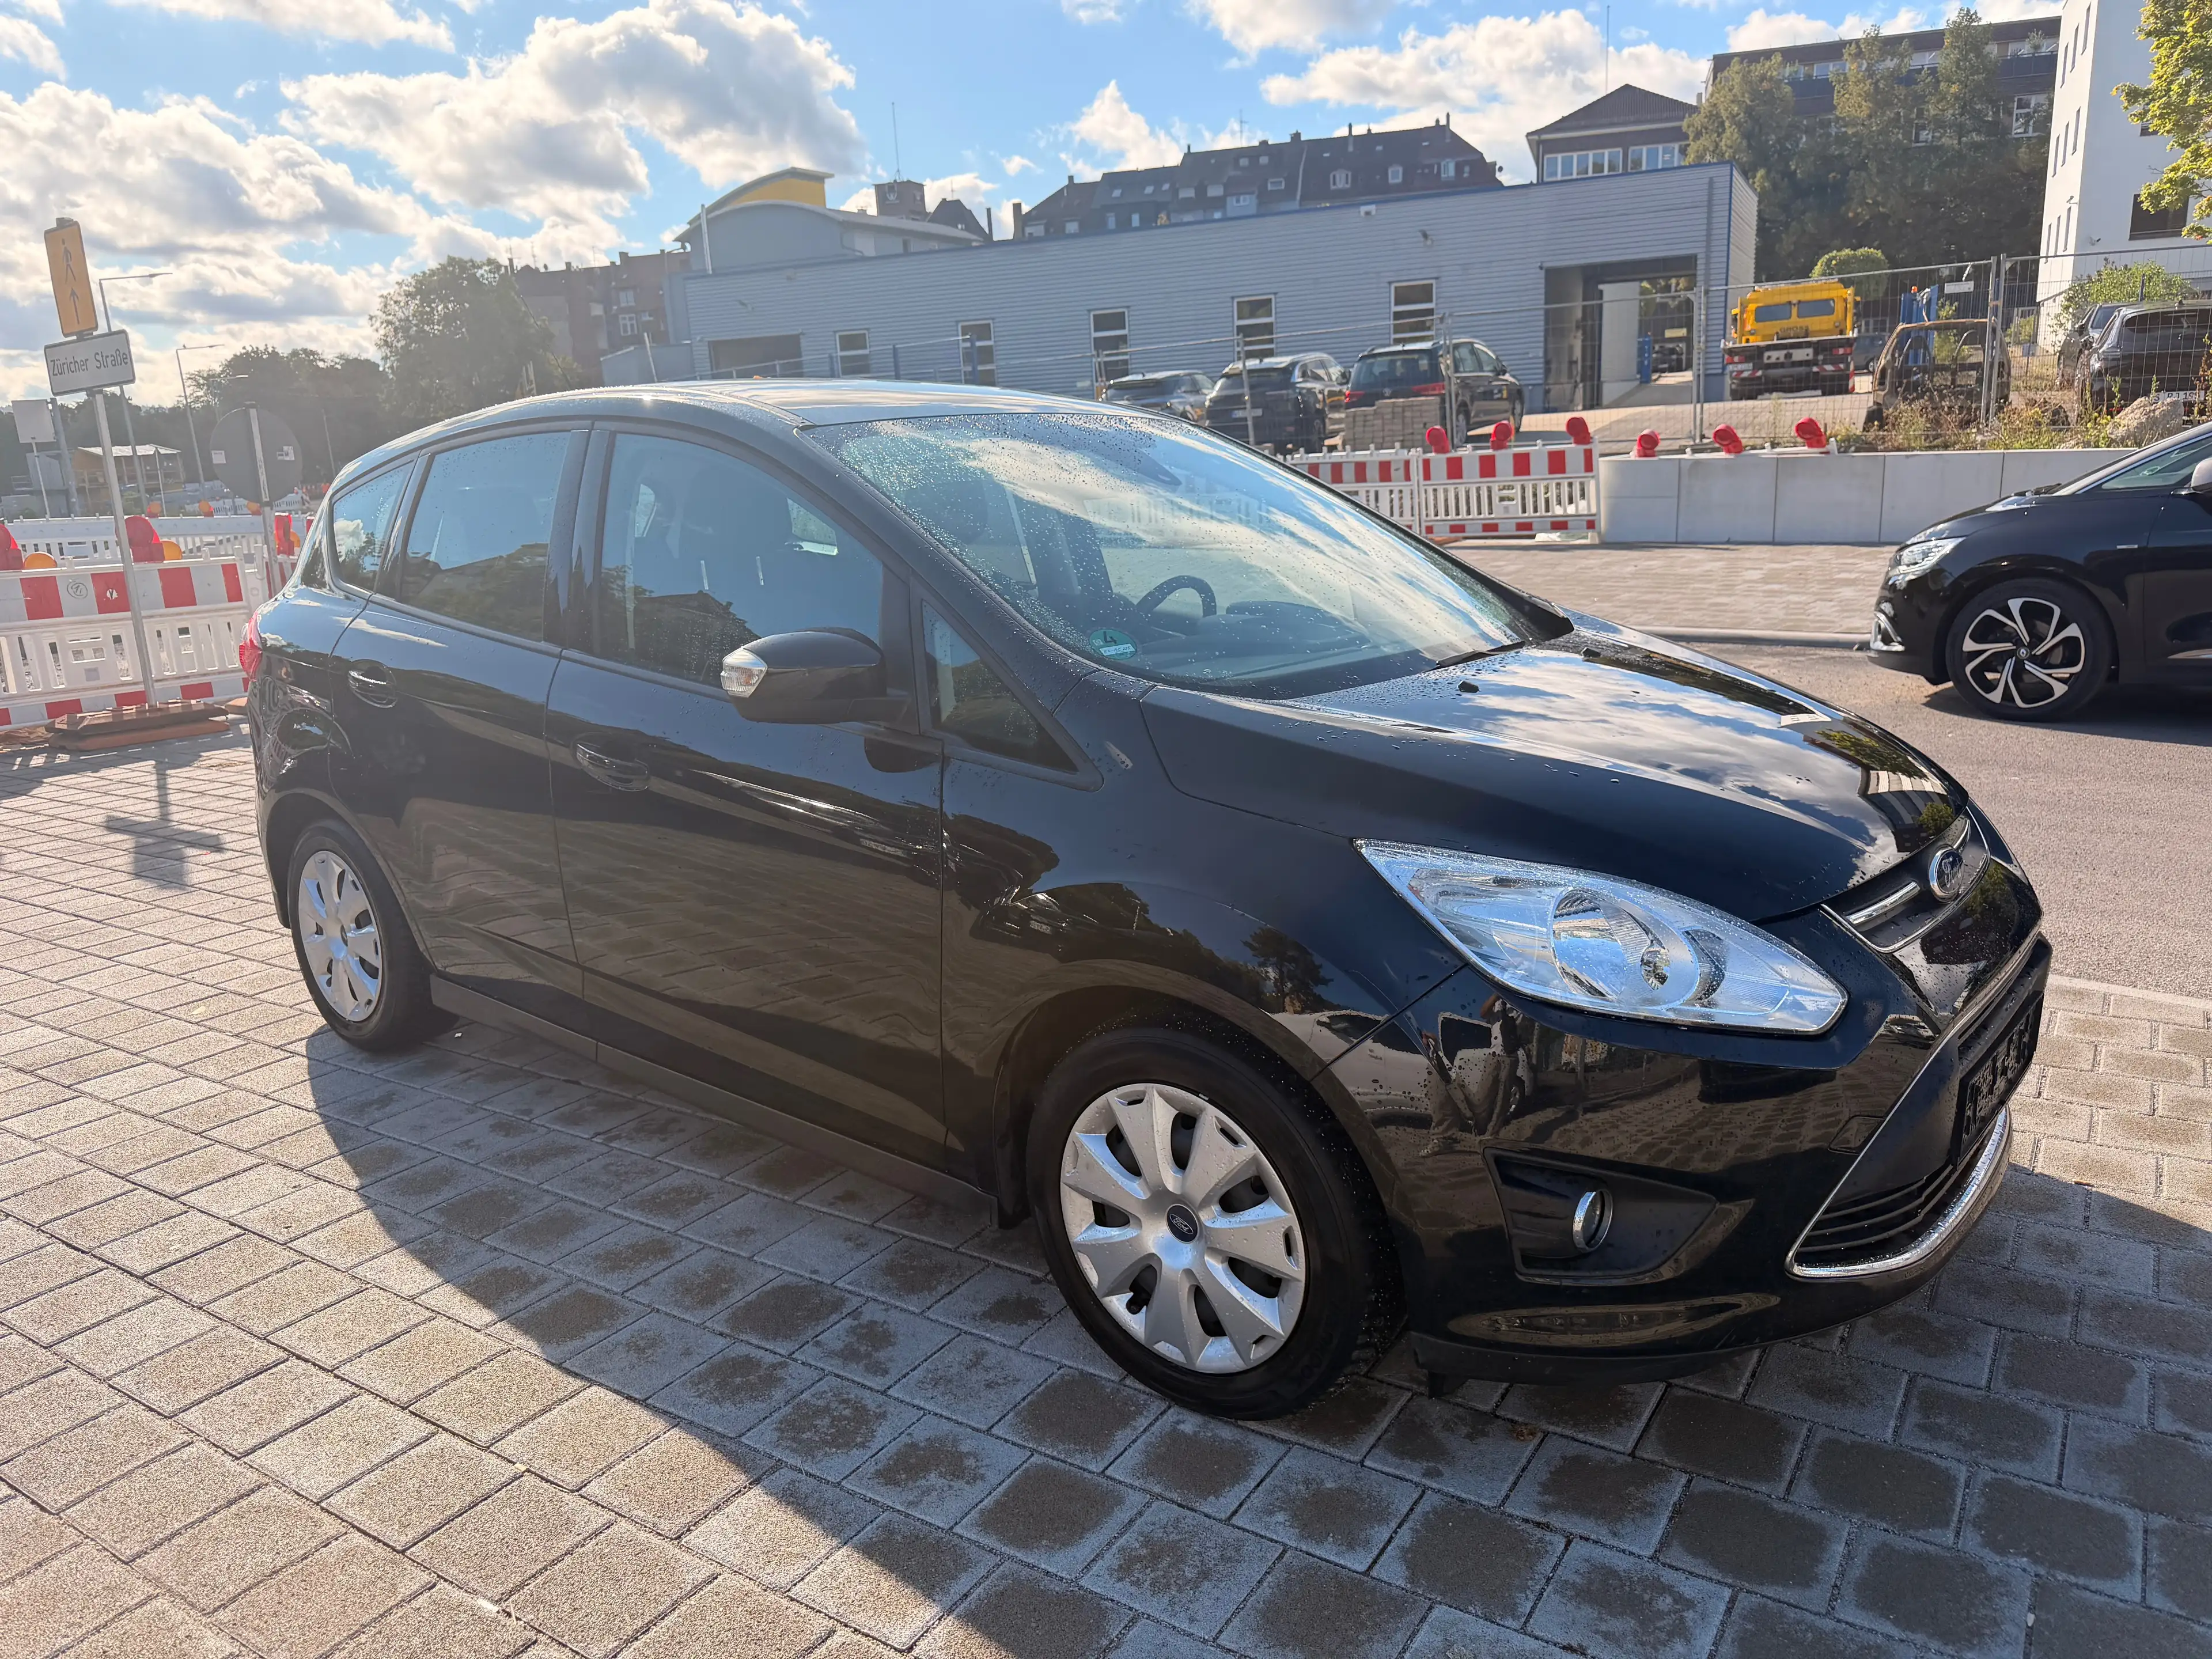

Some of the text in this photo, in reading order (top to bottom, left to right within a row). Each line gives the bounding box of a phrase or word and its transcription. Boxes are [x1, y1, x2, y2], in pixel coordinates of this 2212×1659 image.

[51, 348, 128, 376] Züricher Straße
[1103, 631, 1118, 645] 4
[1942, 856, 1961, 888] Ford
[1173, 1217, 1190, 1232] Ford
